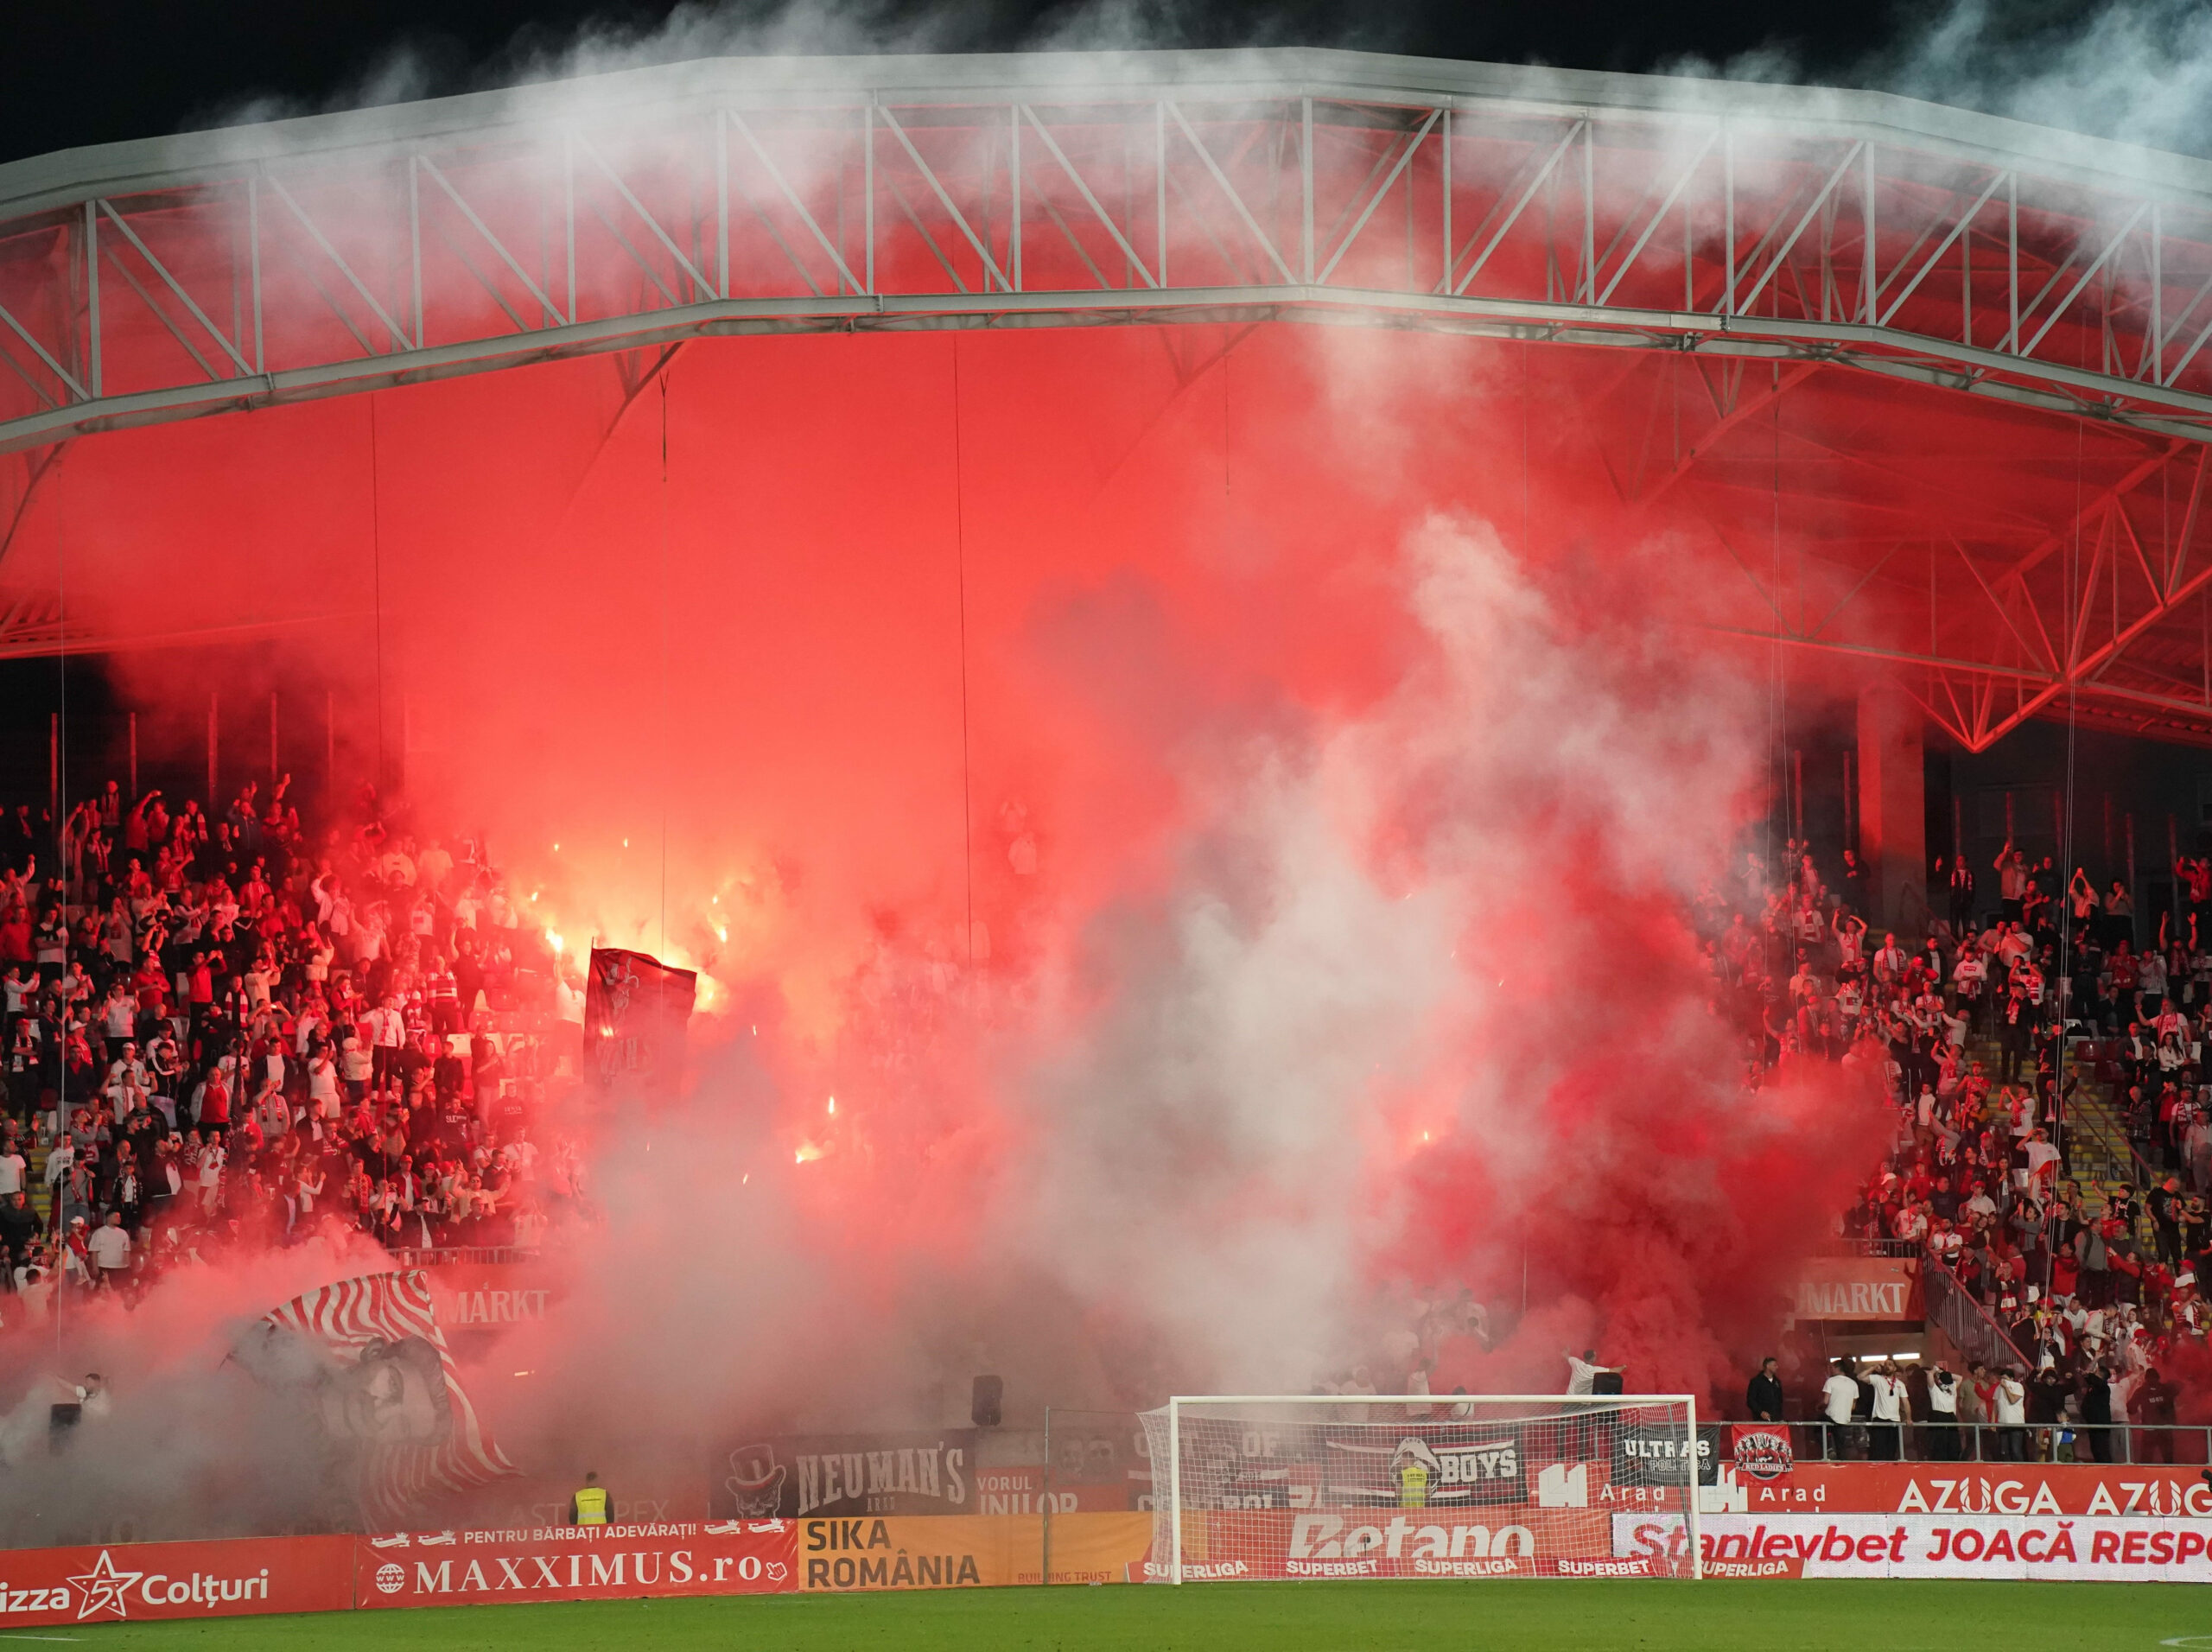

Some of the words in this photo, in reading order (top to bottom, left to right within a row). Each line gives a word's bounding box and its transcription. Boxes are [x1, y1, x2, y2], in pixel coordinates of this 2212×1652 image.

[1440, 1449, 1517, 1483] BOYS
[1649, 1458, 1711, 1471] POLITA
[795, 1441, 965, 1516] NEUMAN'S
[1599, 1484, 1665, 1501] Arad
[1760, 1484, 1826, 1502] Arad
[1897, 1477, 2063, 1514] AZUGA
[464, 1529, 528, 1544] PENTRU
[807, 1519, 892, 1551] SIKA
[1288, 1514, 1535, 1558] Betano
[1926, 1521, 2077, 1563] JOACĂ
[2091, 1530, 2212, 1565] RESP
[413, 1550, 762, 1594] MAXXIMUS.ro
[808, 1548, 981, 1588] ROMÂNIA
[1018, 1573, 1071, 1584] BUILING
[1074, 1571, 1111, 1582] TRUST
[1286, 1559, 1377, 1576] SUPERBET
[1414, 1558, 1518, 1576] SUPERLIGA
[1558, 1560, 1649, 1576] SUPERBET
[1695, 1560, 1789, 1577] UPERLIGA
[142, 1568, 269, 1609] Colțuri
